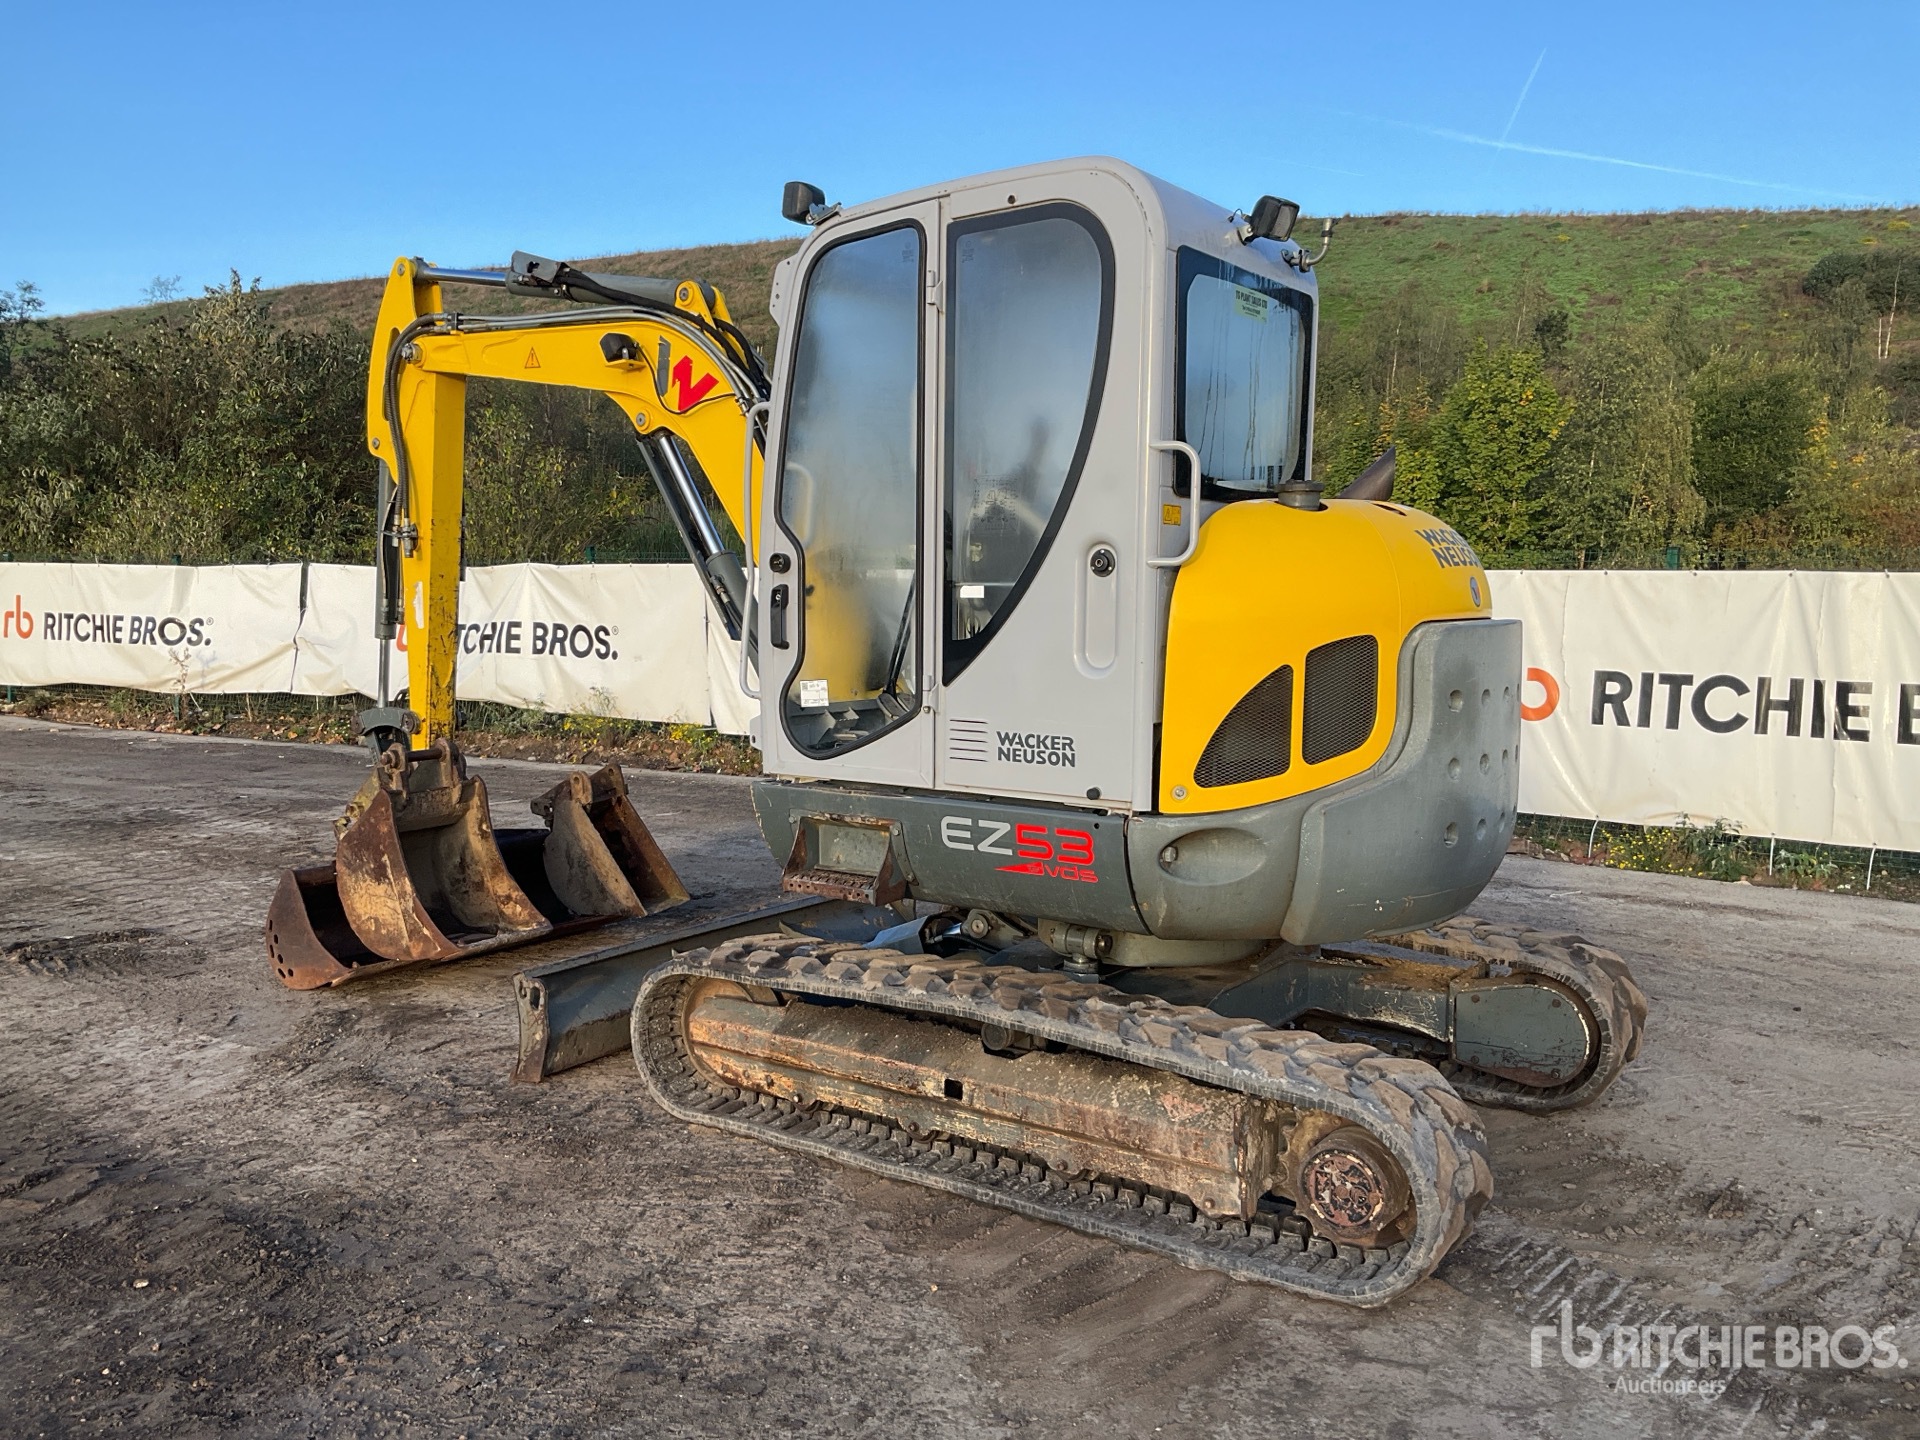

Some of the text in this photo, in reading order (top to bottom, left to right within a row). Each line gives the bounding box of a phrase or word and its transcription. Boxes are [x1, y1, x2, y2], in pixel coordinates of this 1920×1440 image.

[1415, 528, 1468, 546] WACK
[1431, 546, 1480, 568] NEUSO
[4, 595, 212, 647] rb RITCHIE BROS.
[456, 621, 619, 661] TCHIE BROS.
[1591, 669, 1874, 743] RITCHIE
[996, 731, 1075, 752] WACKER
[997, 746, 1076, 768] NEUSON
[941, 815, 1095, 867] EZ53
